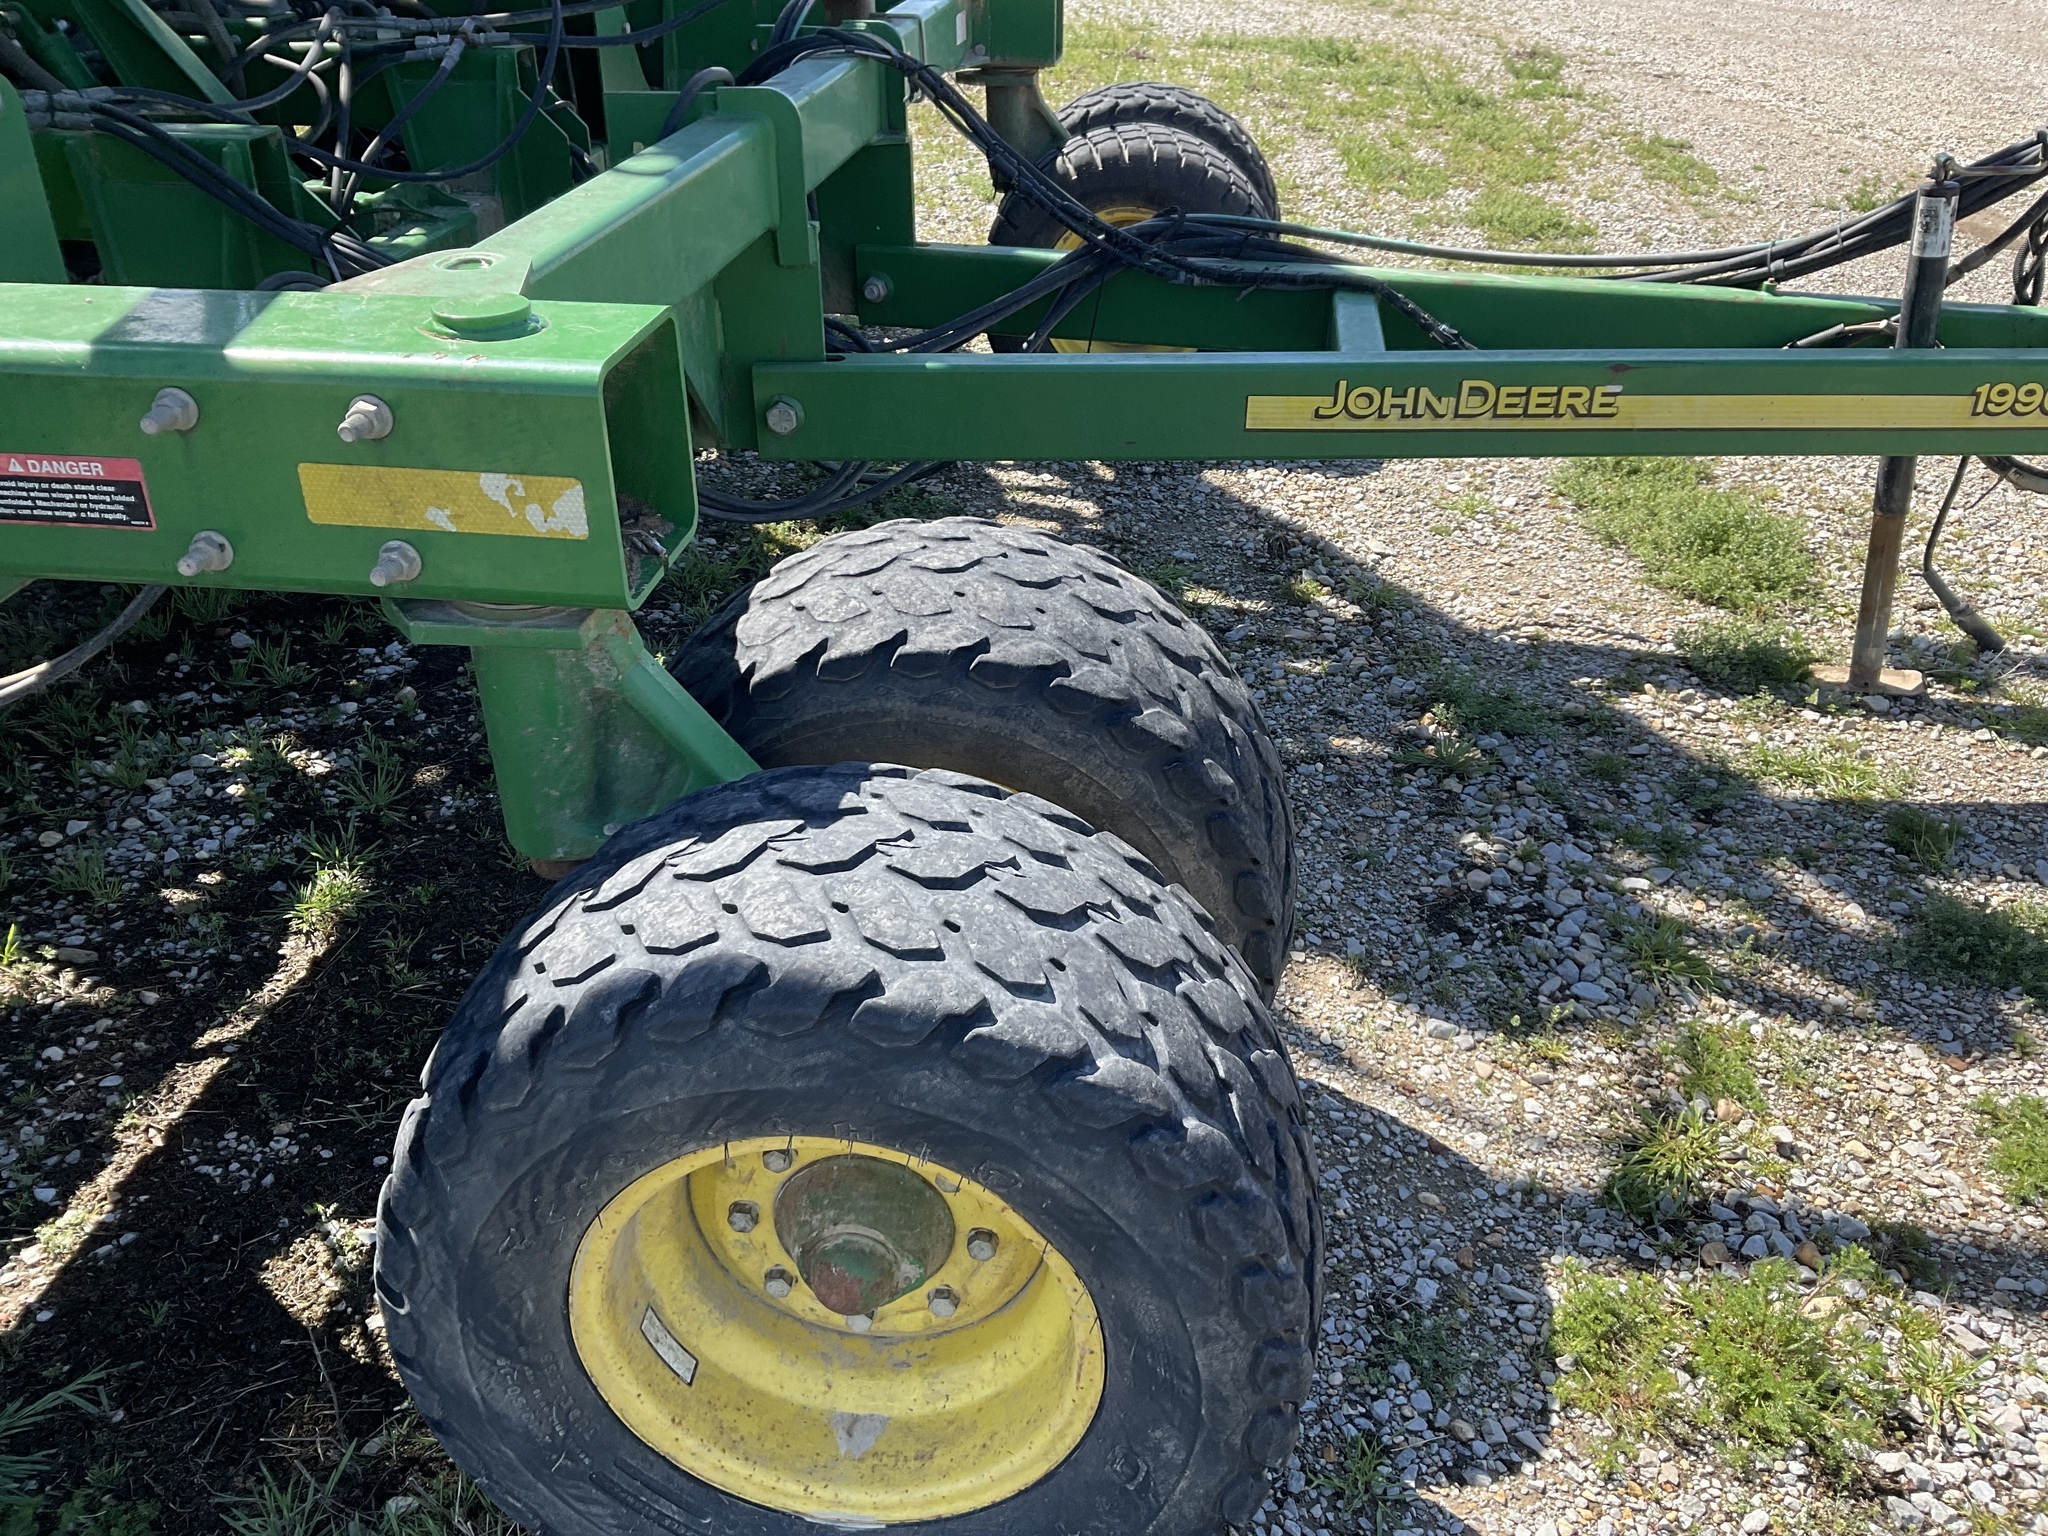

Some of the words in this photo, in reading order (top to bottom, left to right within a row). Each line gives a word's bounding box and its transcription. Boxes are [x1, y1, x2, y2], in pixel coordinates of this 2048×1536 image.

[1314, 379, 1450, 419] JOHN
[1453, 379, 1624, 419] DEERE
[1971, 381, 2048, 416] 199
[26, 459, 104, 476] DANGER
[17, 480, 39, 490] injury
[51, 482, 73, 490] death
[96, 484, 115, 492] clear
[28, 490, 50, 498] when
[50, 491, 74, 500] wings
[88, 493, 110, 502] being
[111, 494, 135, 502] folded
[35, 499, 78, 508] Mechanical
[89, 502, 124, 510] hydraulic
[53, 509, 77, 518] wings
[101, 512, 129, 521] rapidly.
